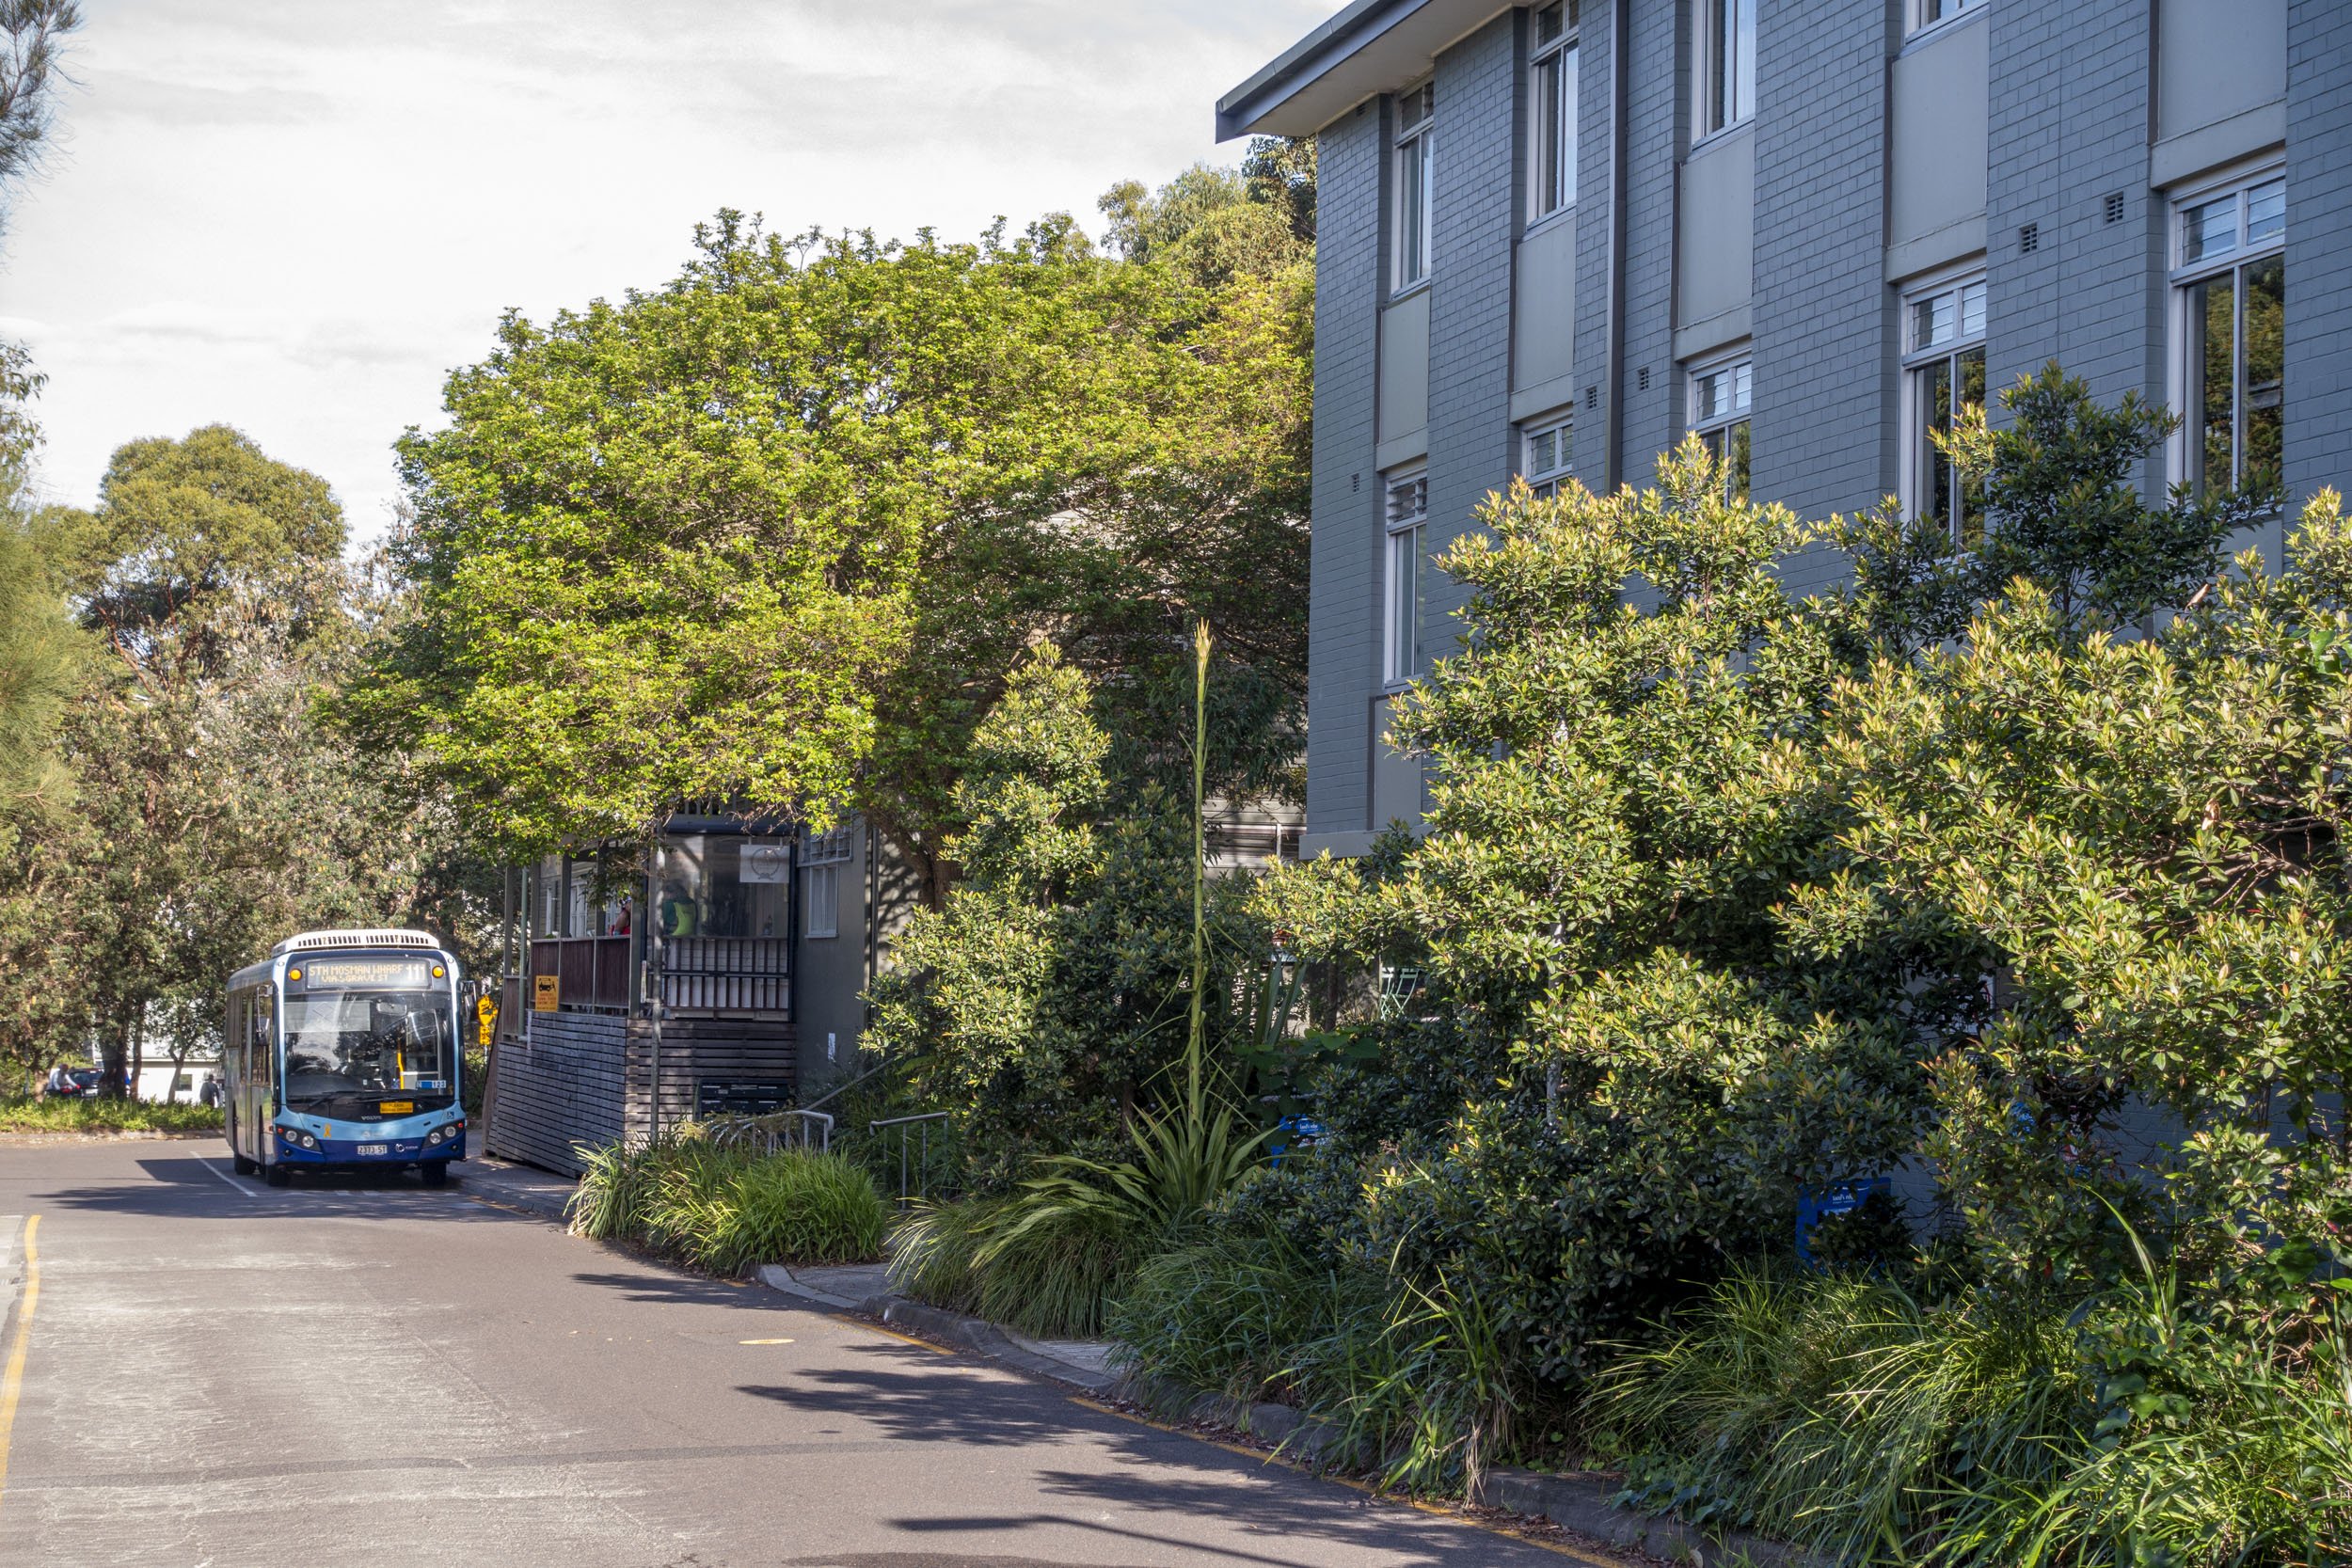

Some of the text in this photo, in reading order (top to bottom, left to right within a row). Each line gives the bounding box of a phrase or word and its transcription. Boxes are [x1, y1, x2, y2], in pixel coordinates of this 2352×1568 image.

[330, 965, 371, 975] MOSMAN
[373, 964, 404, 974] WHARF
[405, 964, 426, 981] 111
